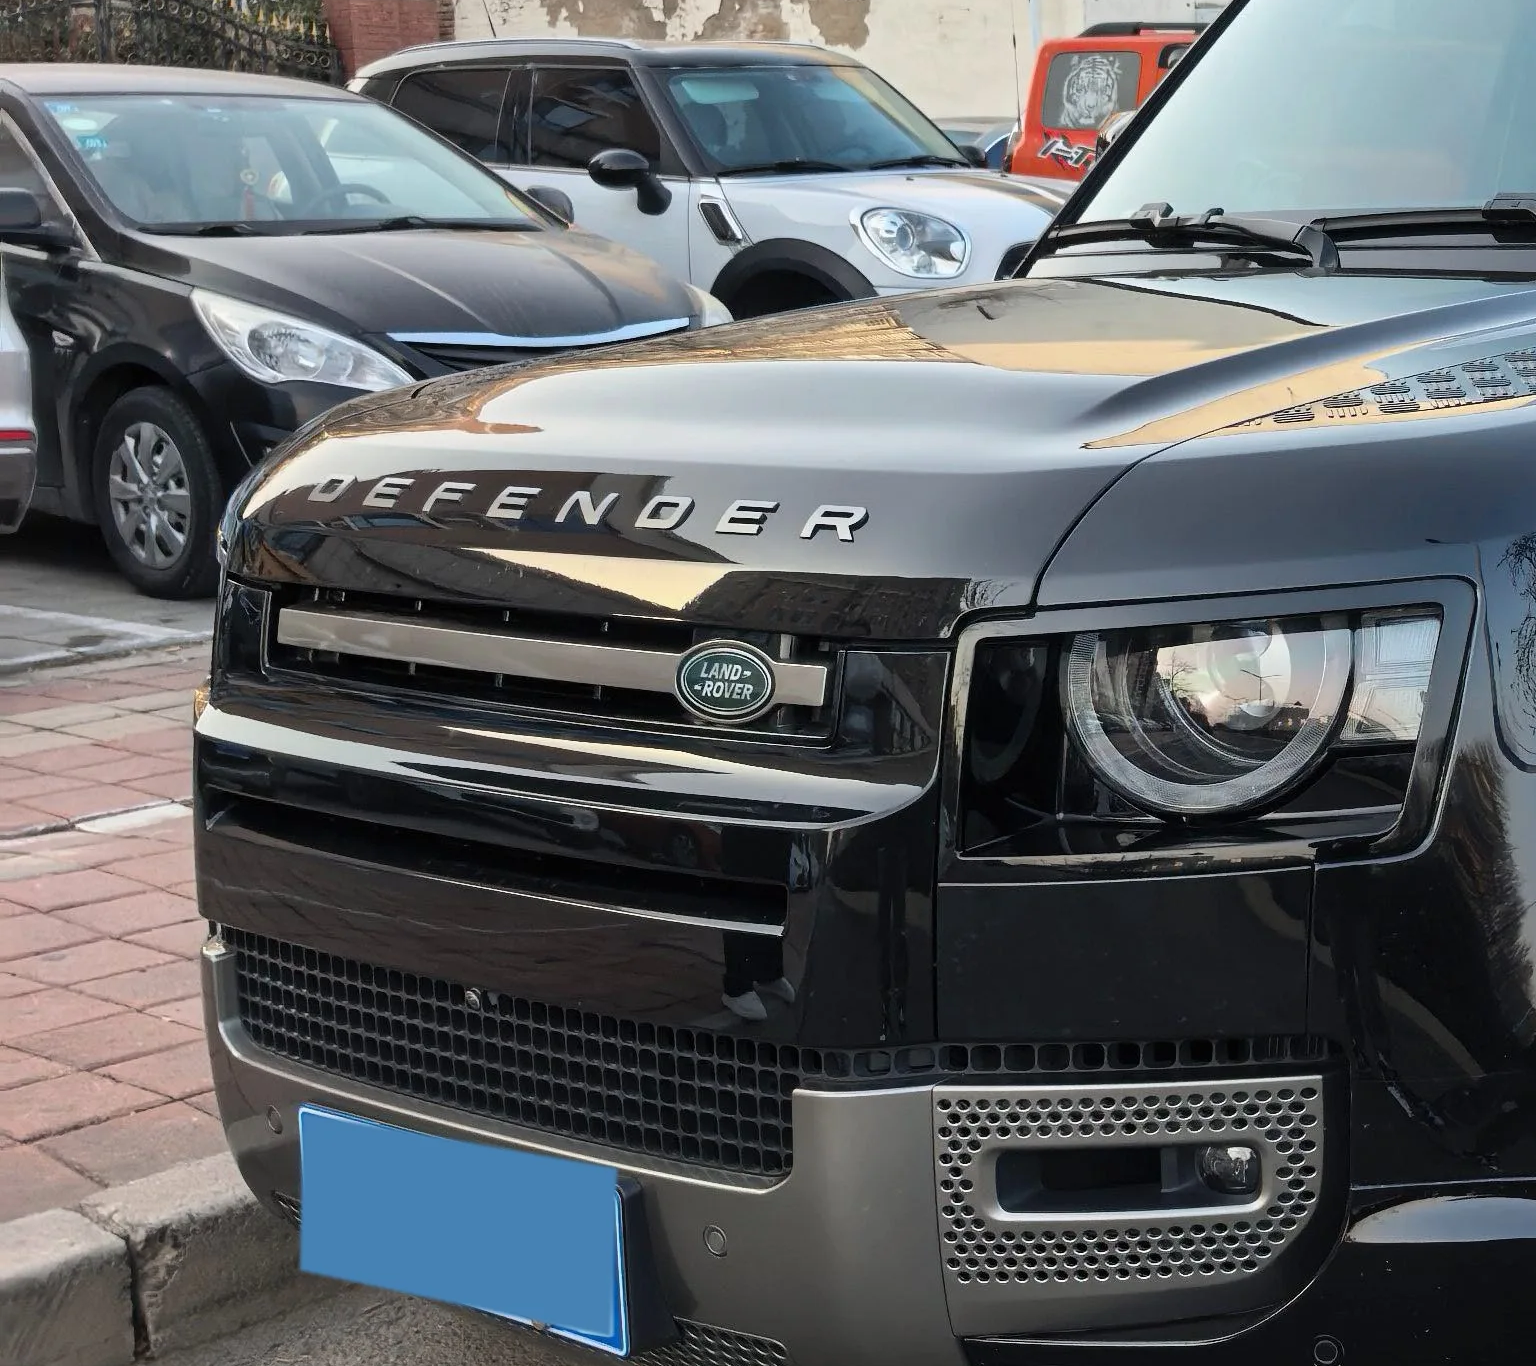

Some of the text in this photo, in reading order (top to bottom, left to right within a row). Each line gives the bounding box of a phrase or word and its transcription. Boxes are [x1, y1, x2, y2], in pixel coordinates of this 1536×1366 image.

[306, 473, 870, 543] DEFENDER
[699, 661, 744, 681] LAND
[701, 680, 754, 700] ROVER
